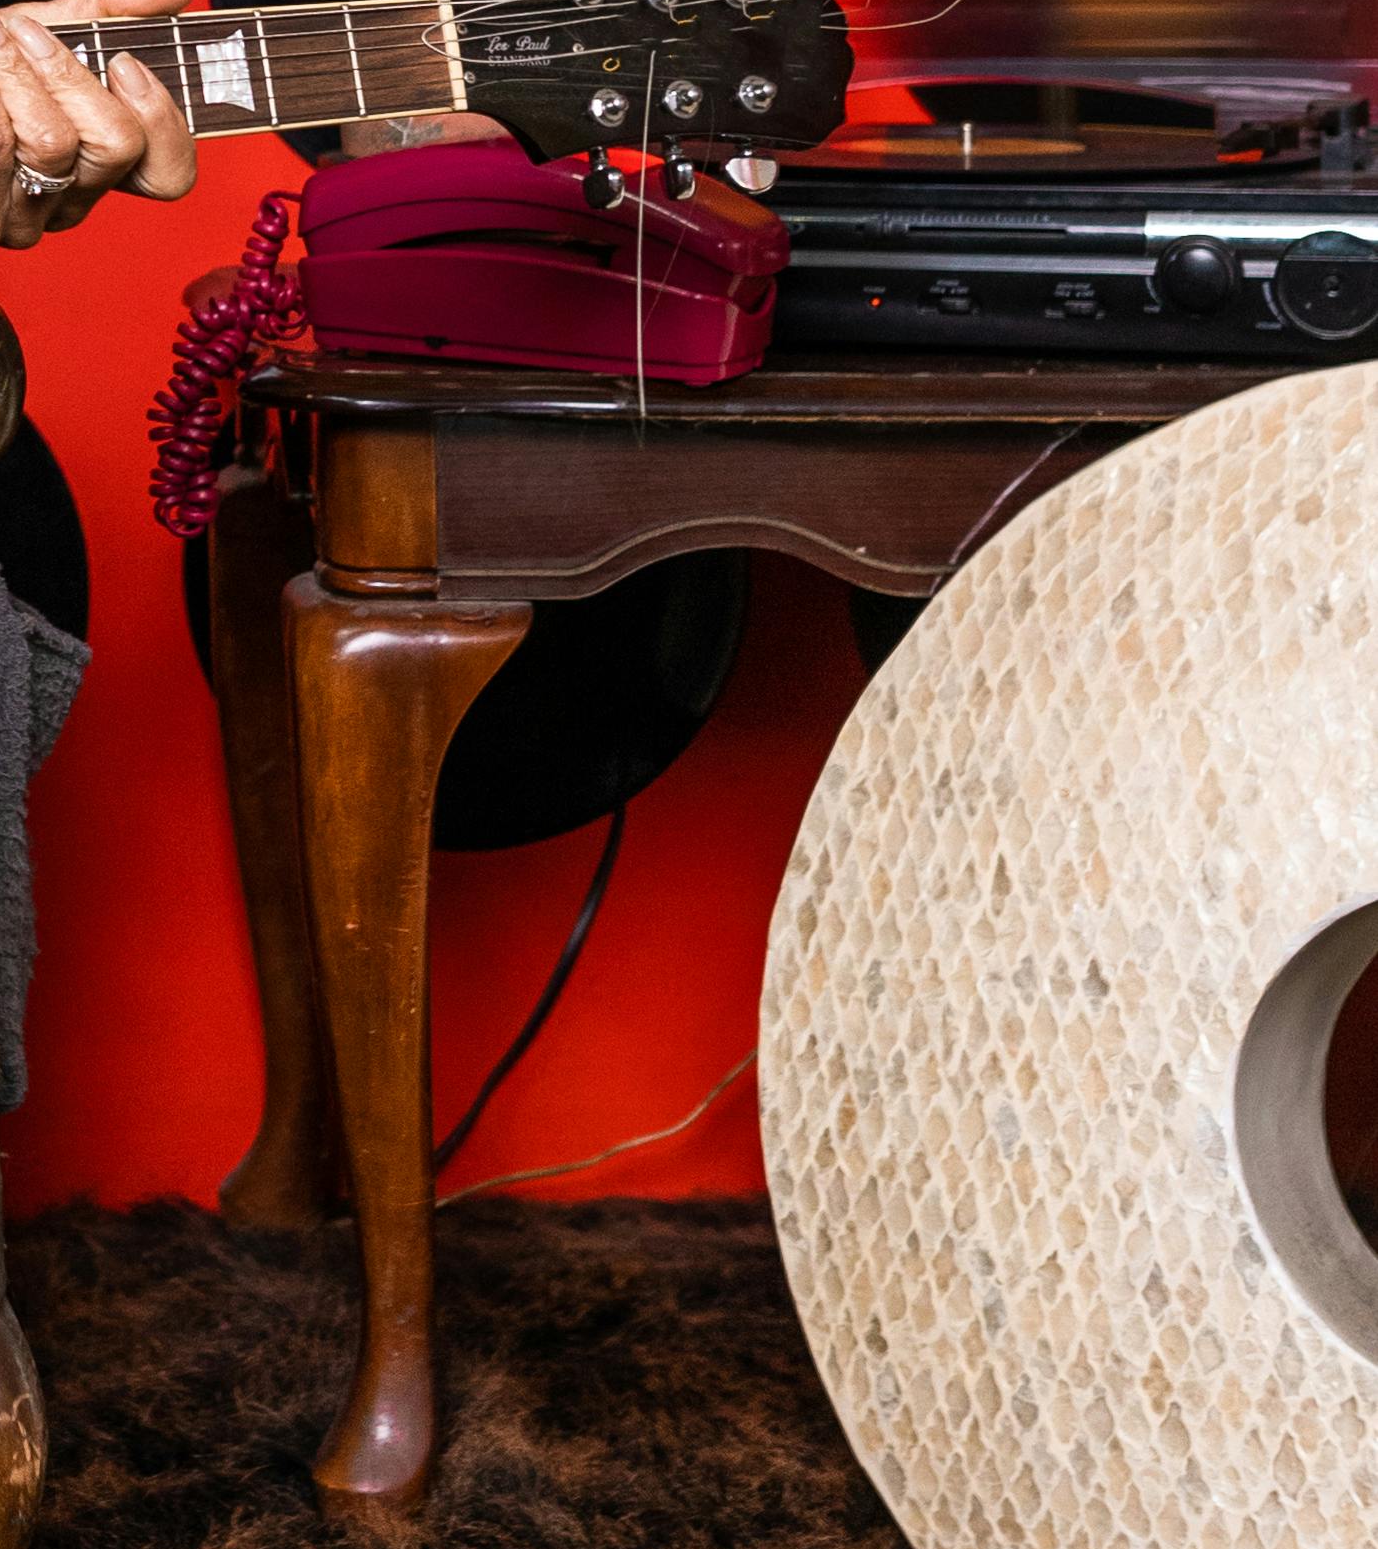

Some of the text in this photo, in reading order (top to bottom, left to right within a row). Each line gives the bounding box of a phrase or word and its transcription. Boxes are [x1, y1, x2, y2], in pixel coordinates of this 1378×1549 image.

[485, 35, 551, 54] Les Paul
[487, 55, 551, 67] STANDARD
